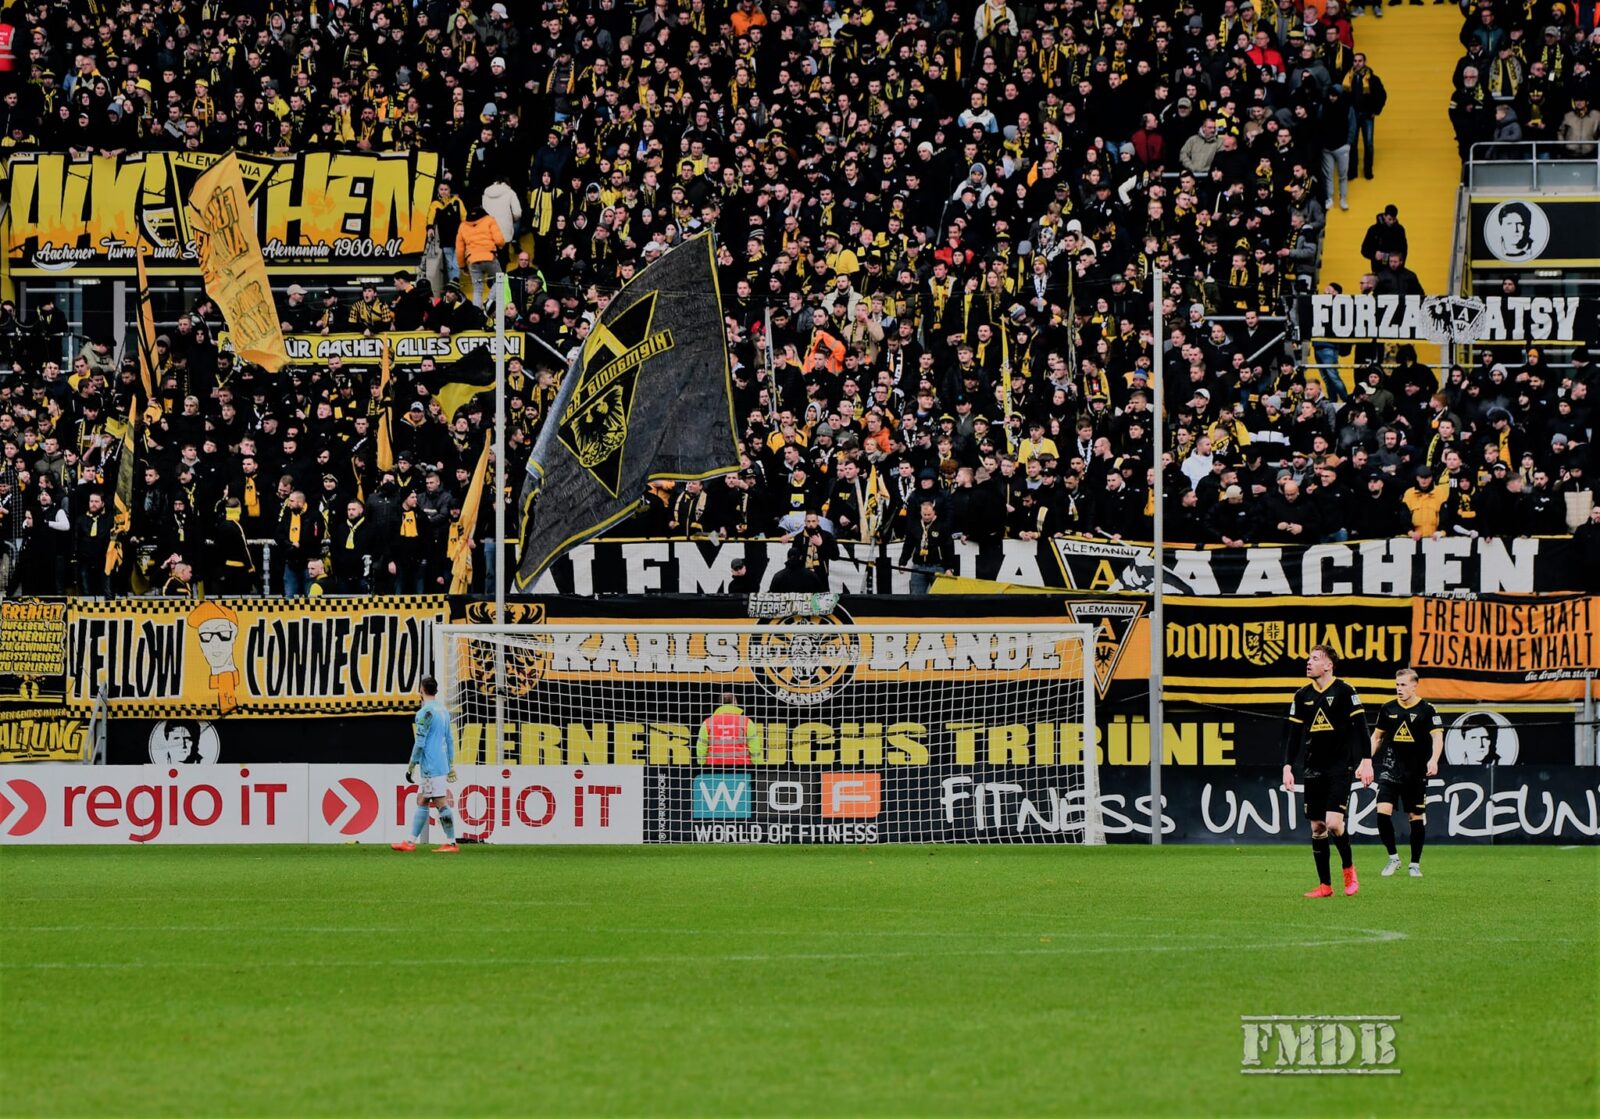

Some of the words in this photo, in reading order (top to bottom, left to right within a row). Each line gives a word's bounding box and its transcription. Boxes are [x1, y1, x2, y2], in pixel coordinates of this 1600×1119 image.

[36, 242, 95, 260] Aachener
[154, 242, 177, 257] und
[262, 239, 330, 257] Alemannia
[334, 238, 373, 257] 1900
[1311, 294, 1420, 338] FORZA
[1485, 297, 1579, 340] ATSV
[285, 338, 312, 357] ÜR
[397, 337, 451, 355] ALLES
[1167, 537, 1539, 595] AACHEN
[2, 604, 64, 620] FREIHEIT
[1075, 605, 1136, 614] ALEMANNIA
[1423, 597, 1592, 637] FREUNDSCHAFT
[1, 631, 63, 642] SICHERHEIT
[550, 631, 739, 673] KARLS
[868, 631, 1061, 671] BANDE
[1418, 632, 1593, 671] ZUSAMMENHALT
[70, 618, 184, 698] YELLOW
[756, 722, 929, 765] UCHS
[945, 713, 1236, 766] TRIBÜNE
[63, 769, 223, 843] regio
[240, 769, 288, 827] iT
[574, 769, 622, 827] iT
[941, 776, 1176, 834] FITNESS
[1201, 782, 1380, 836] UNTR
[694, 825, 762, 843] WORLD
[768, 825, 793, 843] OF
[800, 824, 878, 842] FITNESS
